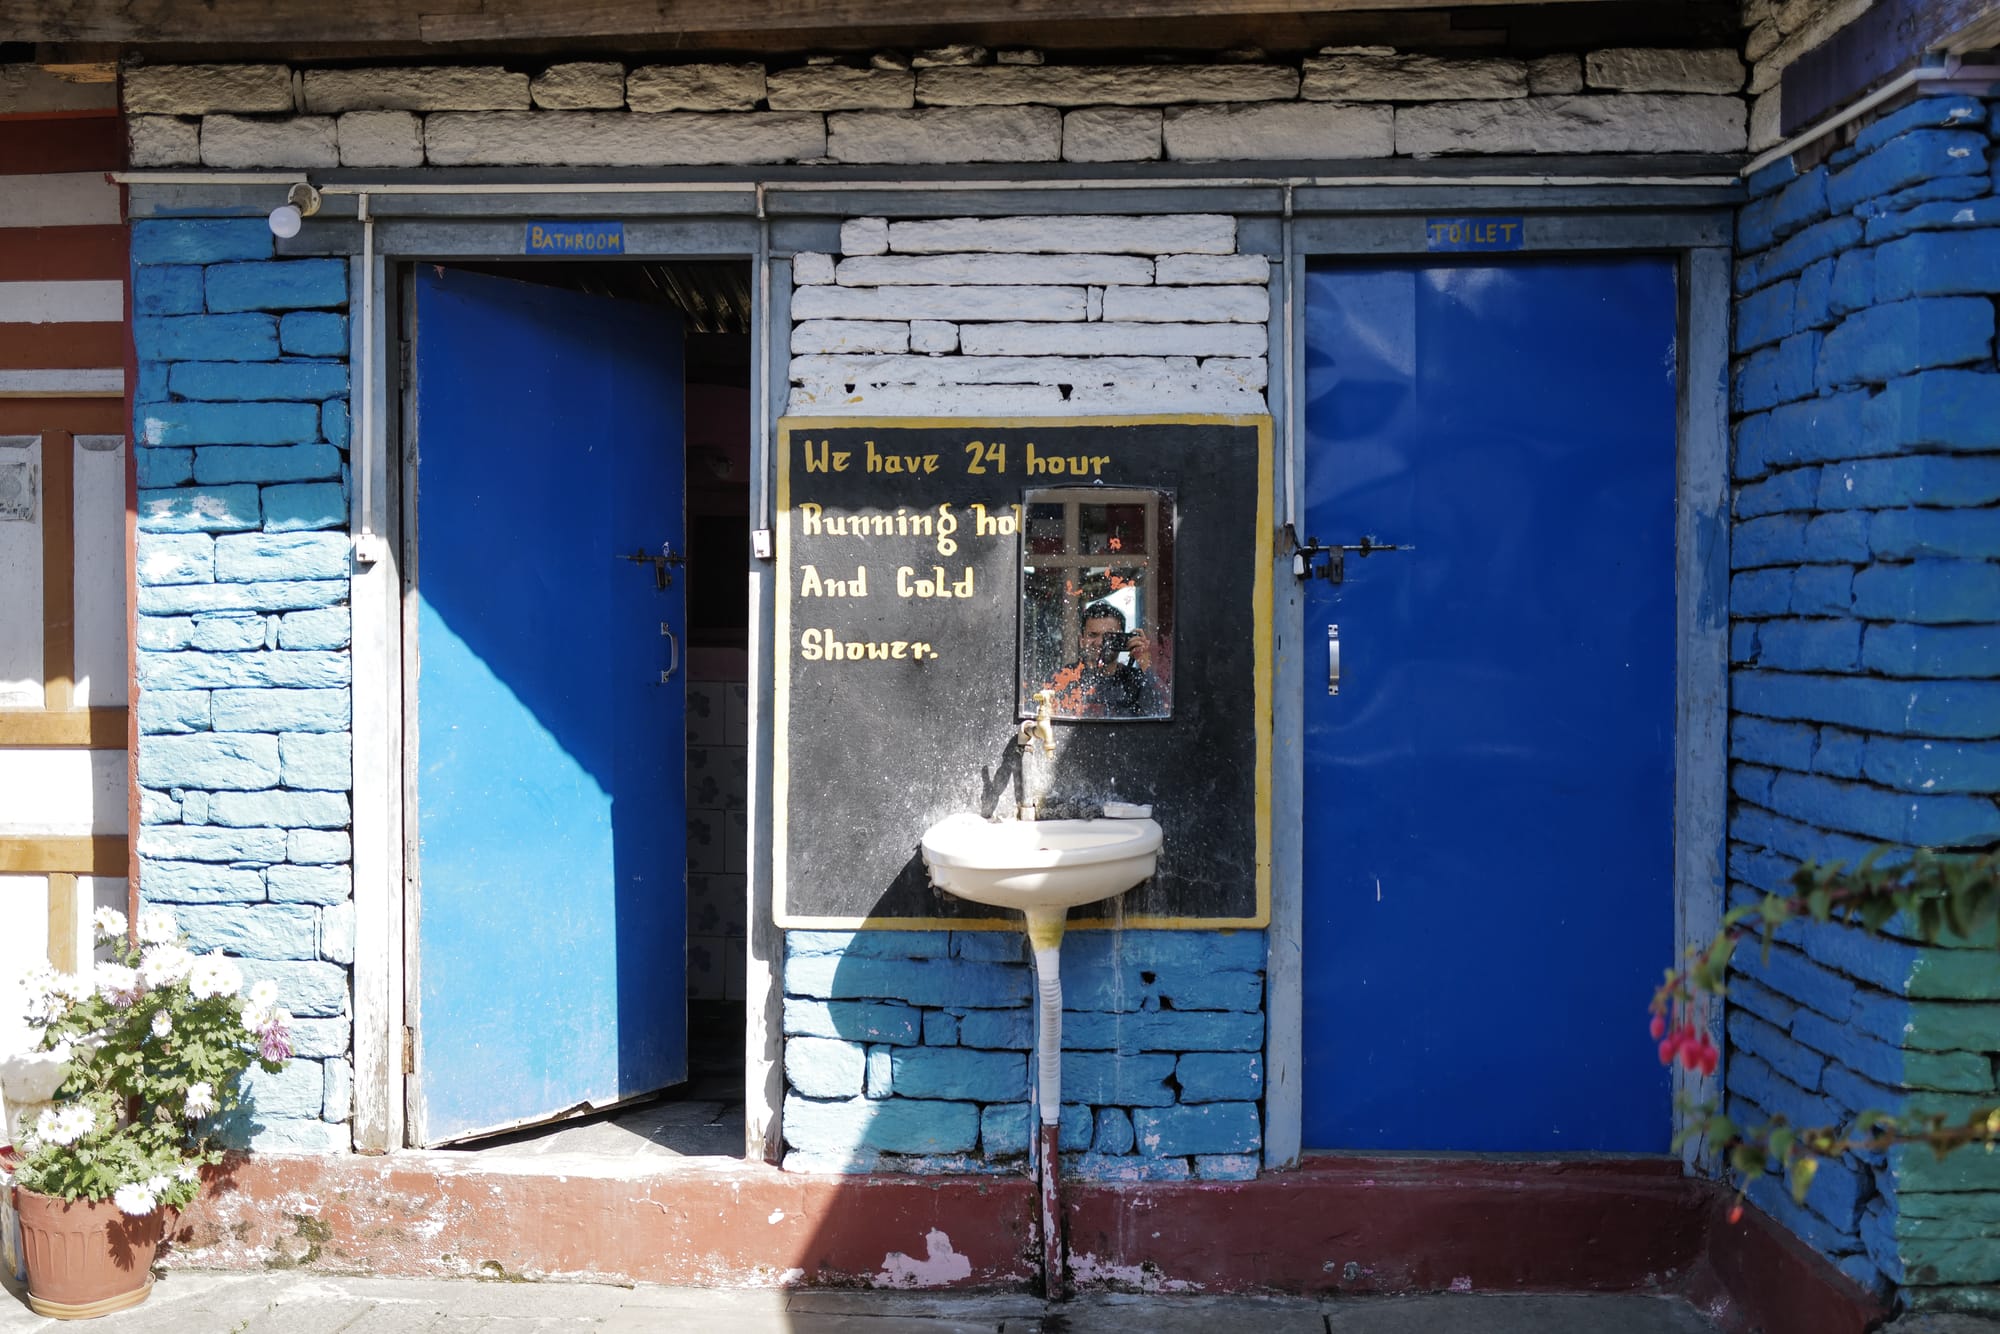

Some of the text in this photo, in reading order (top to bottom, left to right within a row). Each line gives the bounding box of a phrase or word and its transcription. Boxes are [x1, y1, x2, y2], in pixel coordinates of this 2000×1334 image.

[532, 226, 620, 250] BATHROOM
[1431, 224, 1517, 243] TOILET
[804, 440, 1110, 476] We have 24 hour
[799, 502, 958, 556] Running
[800, 564, 868, 598] And
